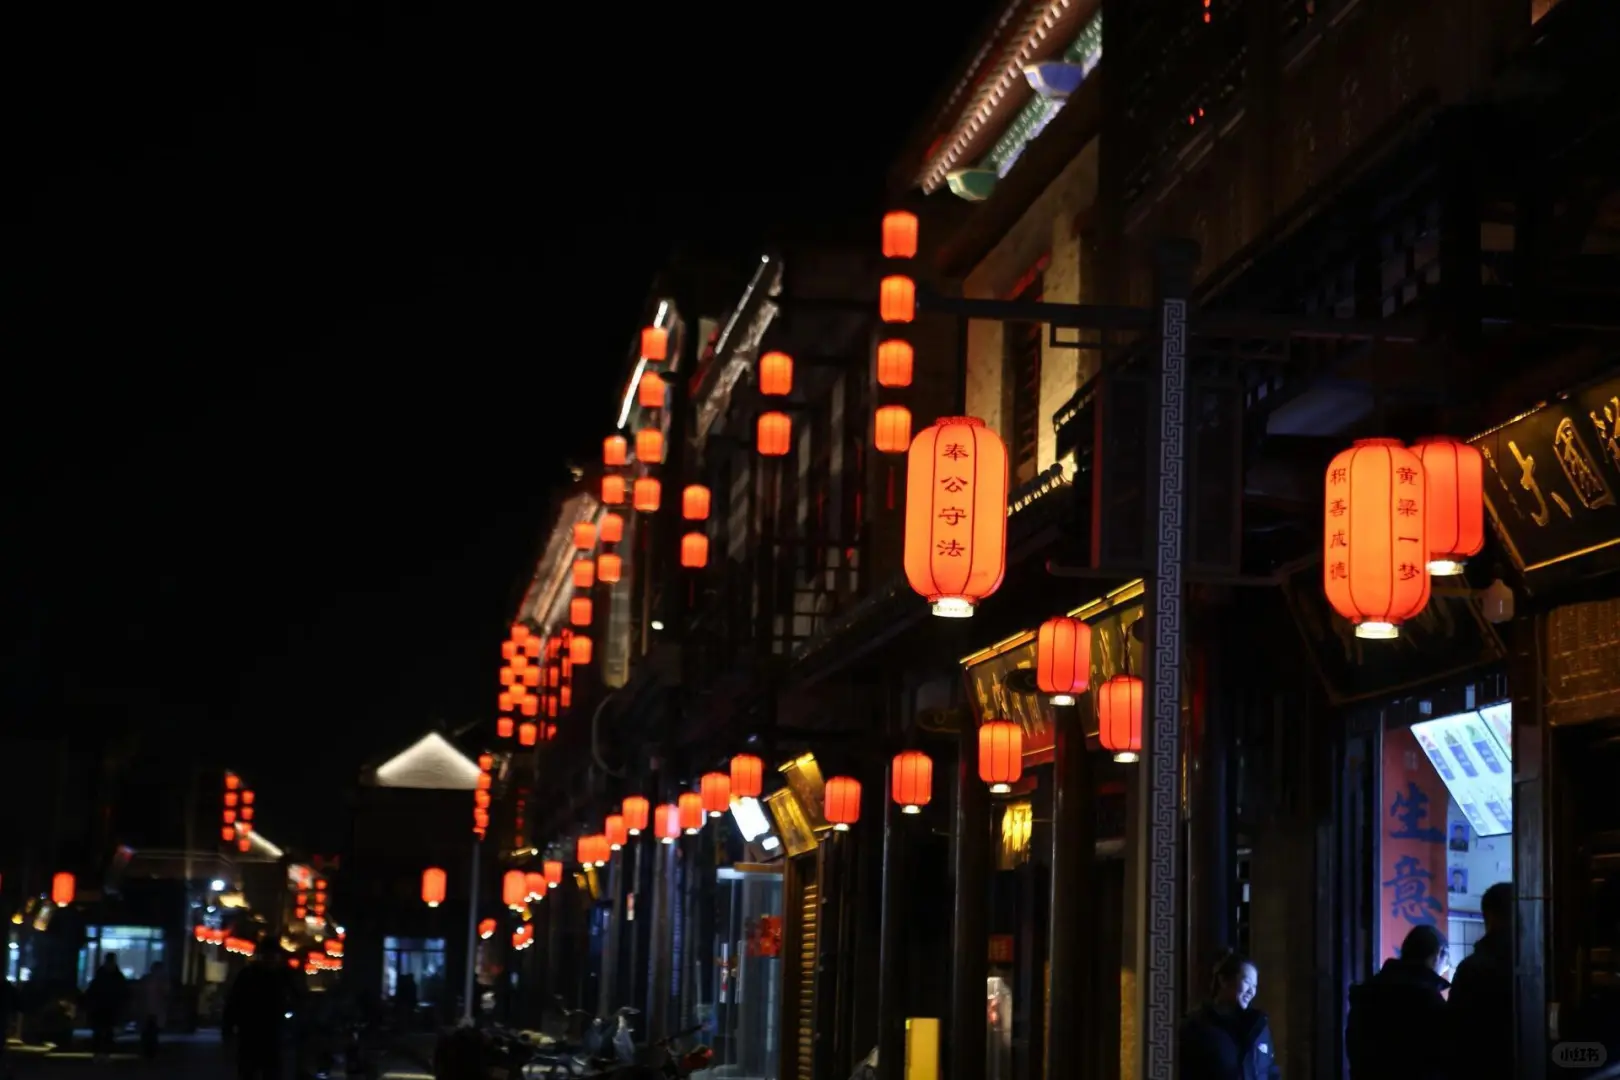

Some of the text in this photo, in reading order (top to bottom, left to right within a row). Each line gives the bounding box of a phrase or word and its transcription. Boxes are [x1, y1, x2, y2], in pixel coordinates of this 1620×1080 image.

[937, 443, 969, 557] 奉公守法
[1330, 468, 1348, 579] 积善成德
[1383, 781, 1448, 957] 生意
